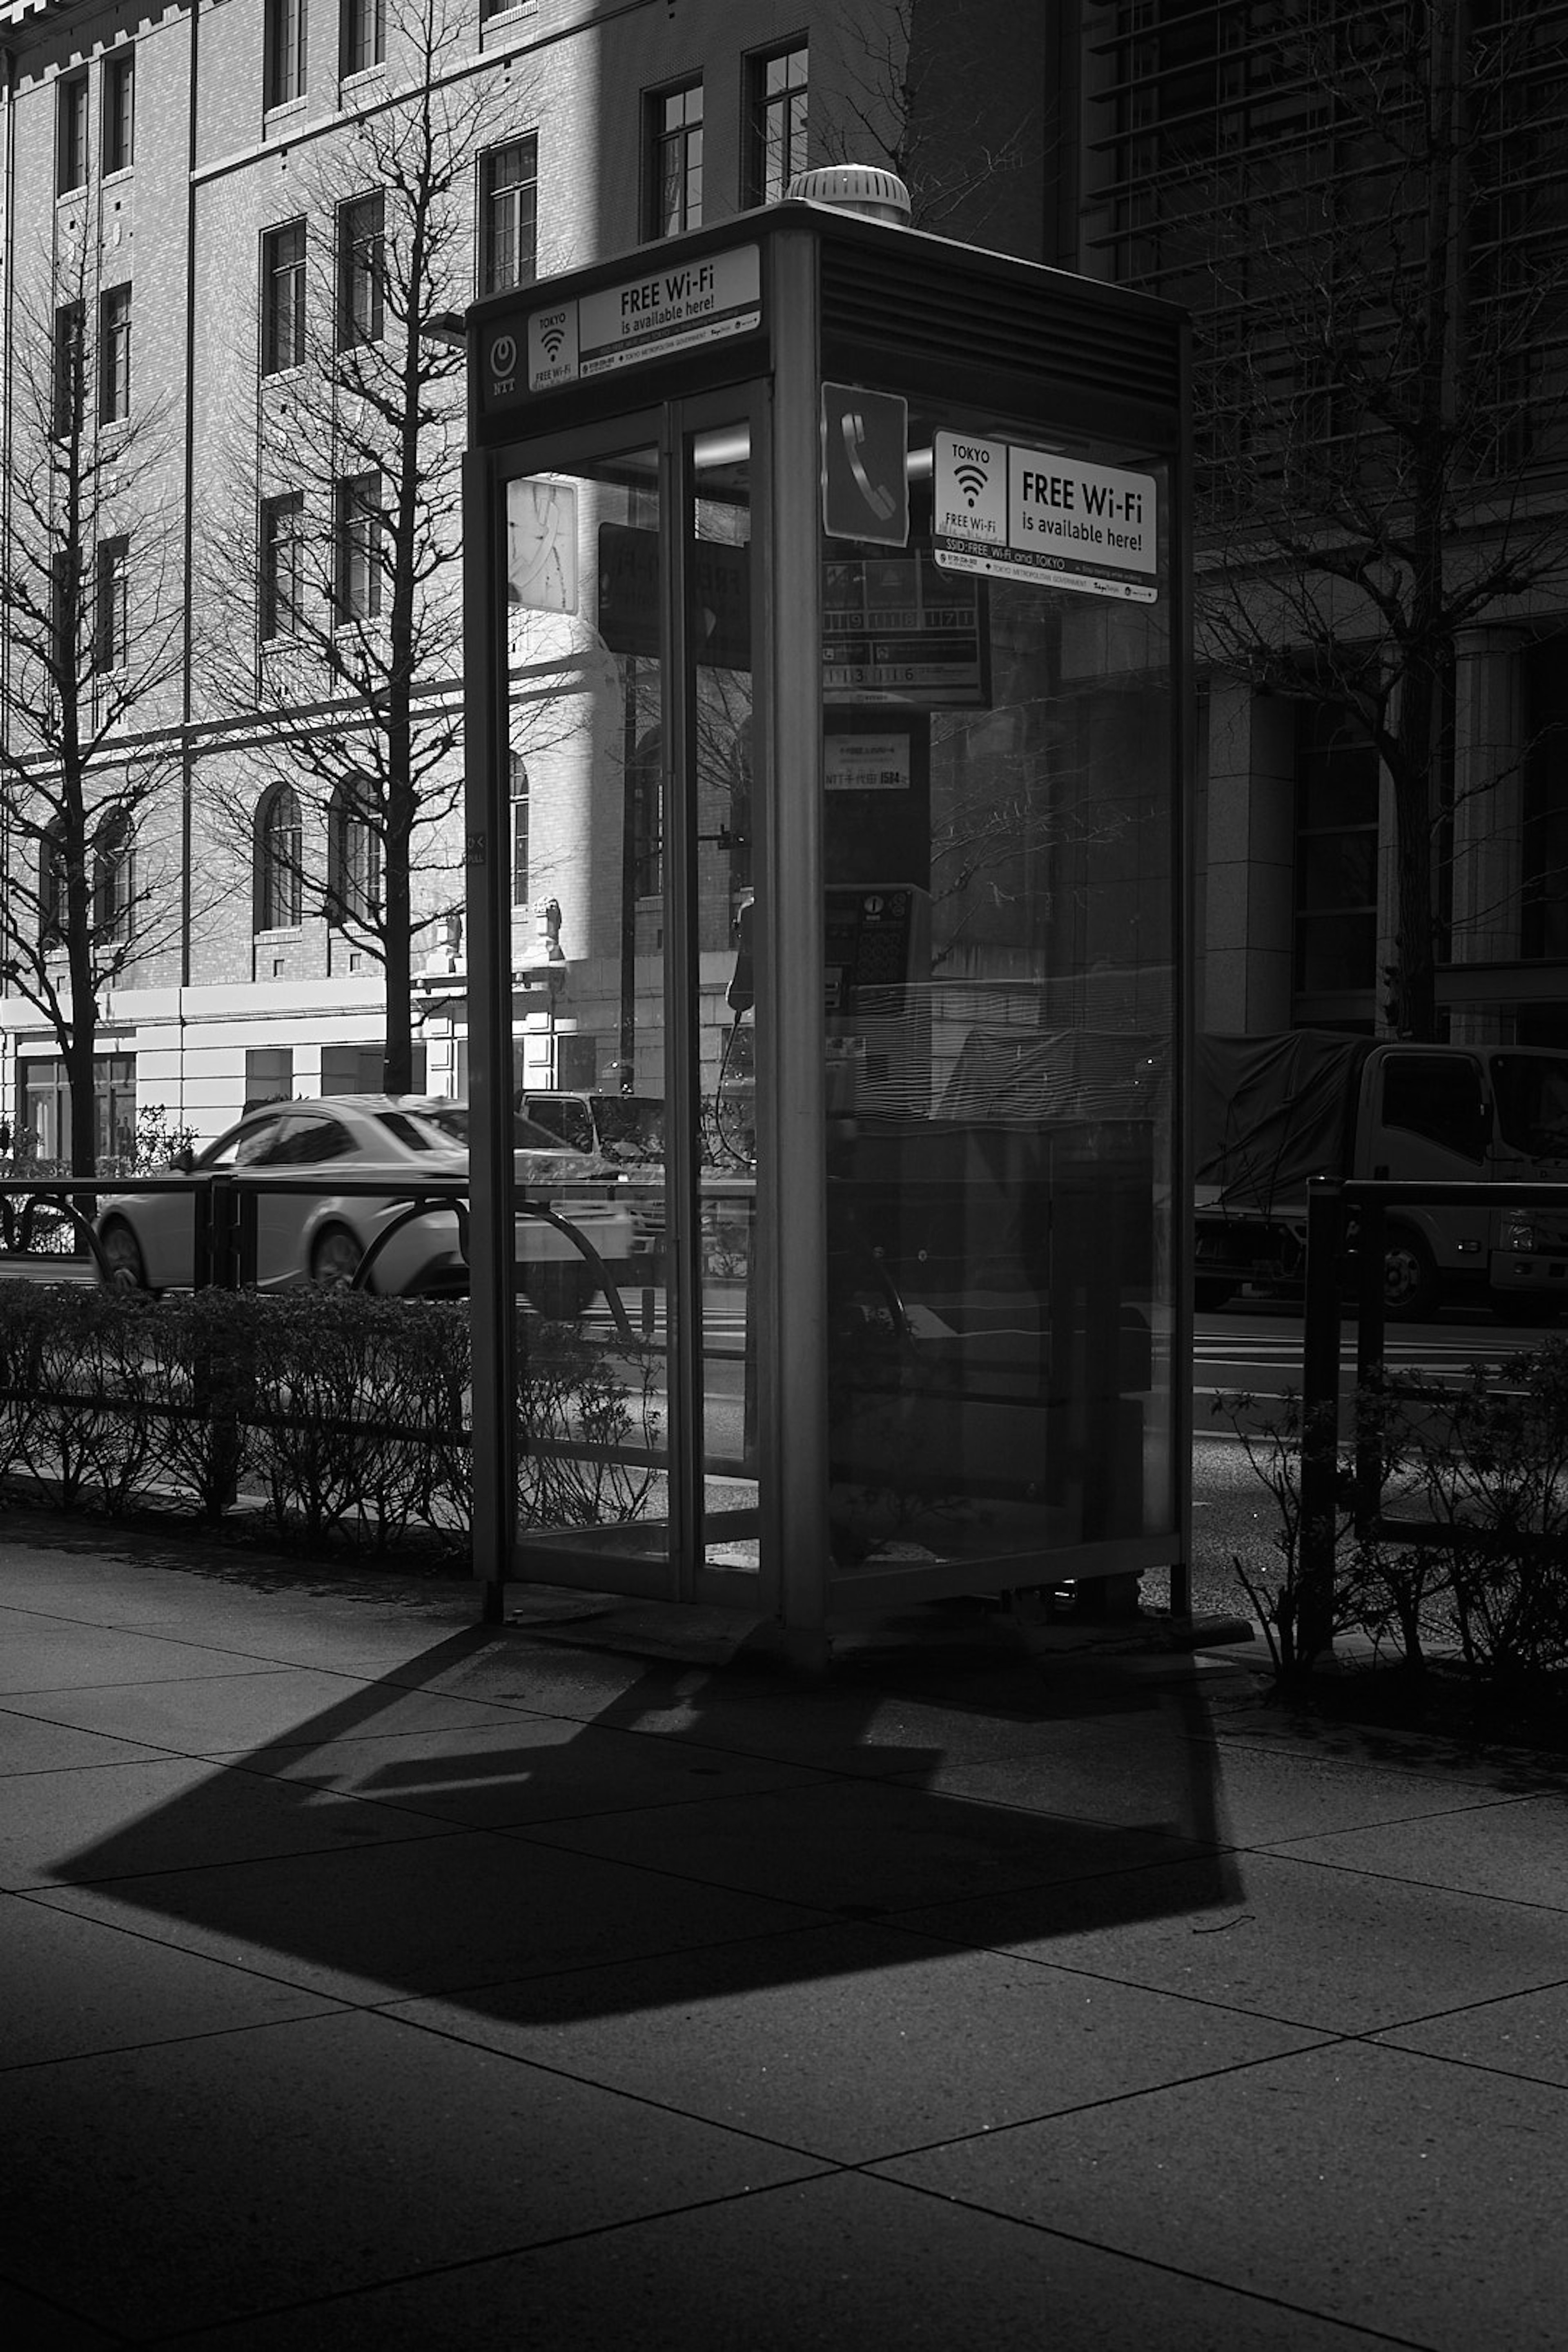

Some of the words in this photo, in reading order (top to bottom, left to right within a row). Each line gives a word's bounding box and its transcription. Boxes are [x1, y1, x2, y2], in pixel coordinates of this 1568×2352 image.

[621, 283, 660, 315] FREE
[666, 265, 714, 301] Wi-Fi
[539, 312, 566, 330] TOKYO
[622, 321, 631, 334] is
[633, 305, 682, 332] available
[686, 295, 714, 315] here!
[536, 370, 552, 382] FREE
[553, 364, 571, 377] Wi-Fi
[493, 378, 515, 396] NTT
[952, 444, 989, 463] TOKYO
[1023, 471, 1074, 510] FREE
[1082, 483, 1142, 523] Wi-Fi
[946, 512, 968, 528] FREE
[971, 517, 996, 533] Wi-Fi
[1023, 512, 1033, 530] is
[1039, 517, 1102, 543] available
[1108, 529, 1142, 551] here!
[931, 612, 969, 626] 171
[830, 668, 863, 682] 113
[879, 668, 913, 681] 116
